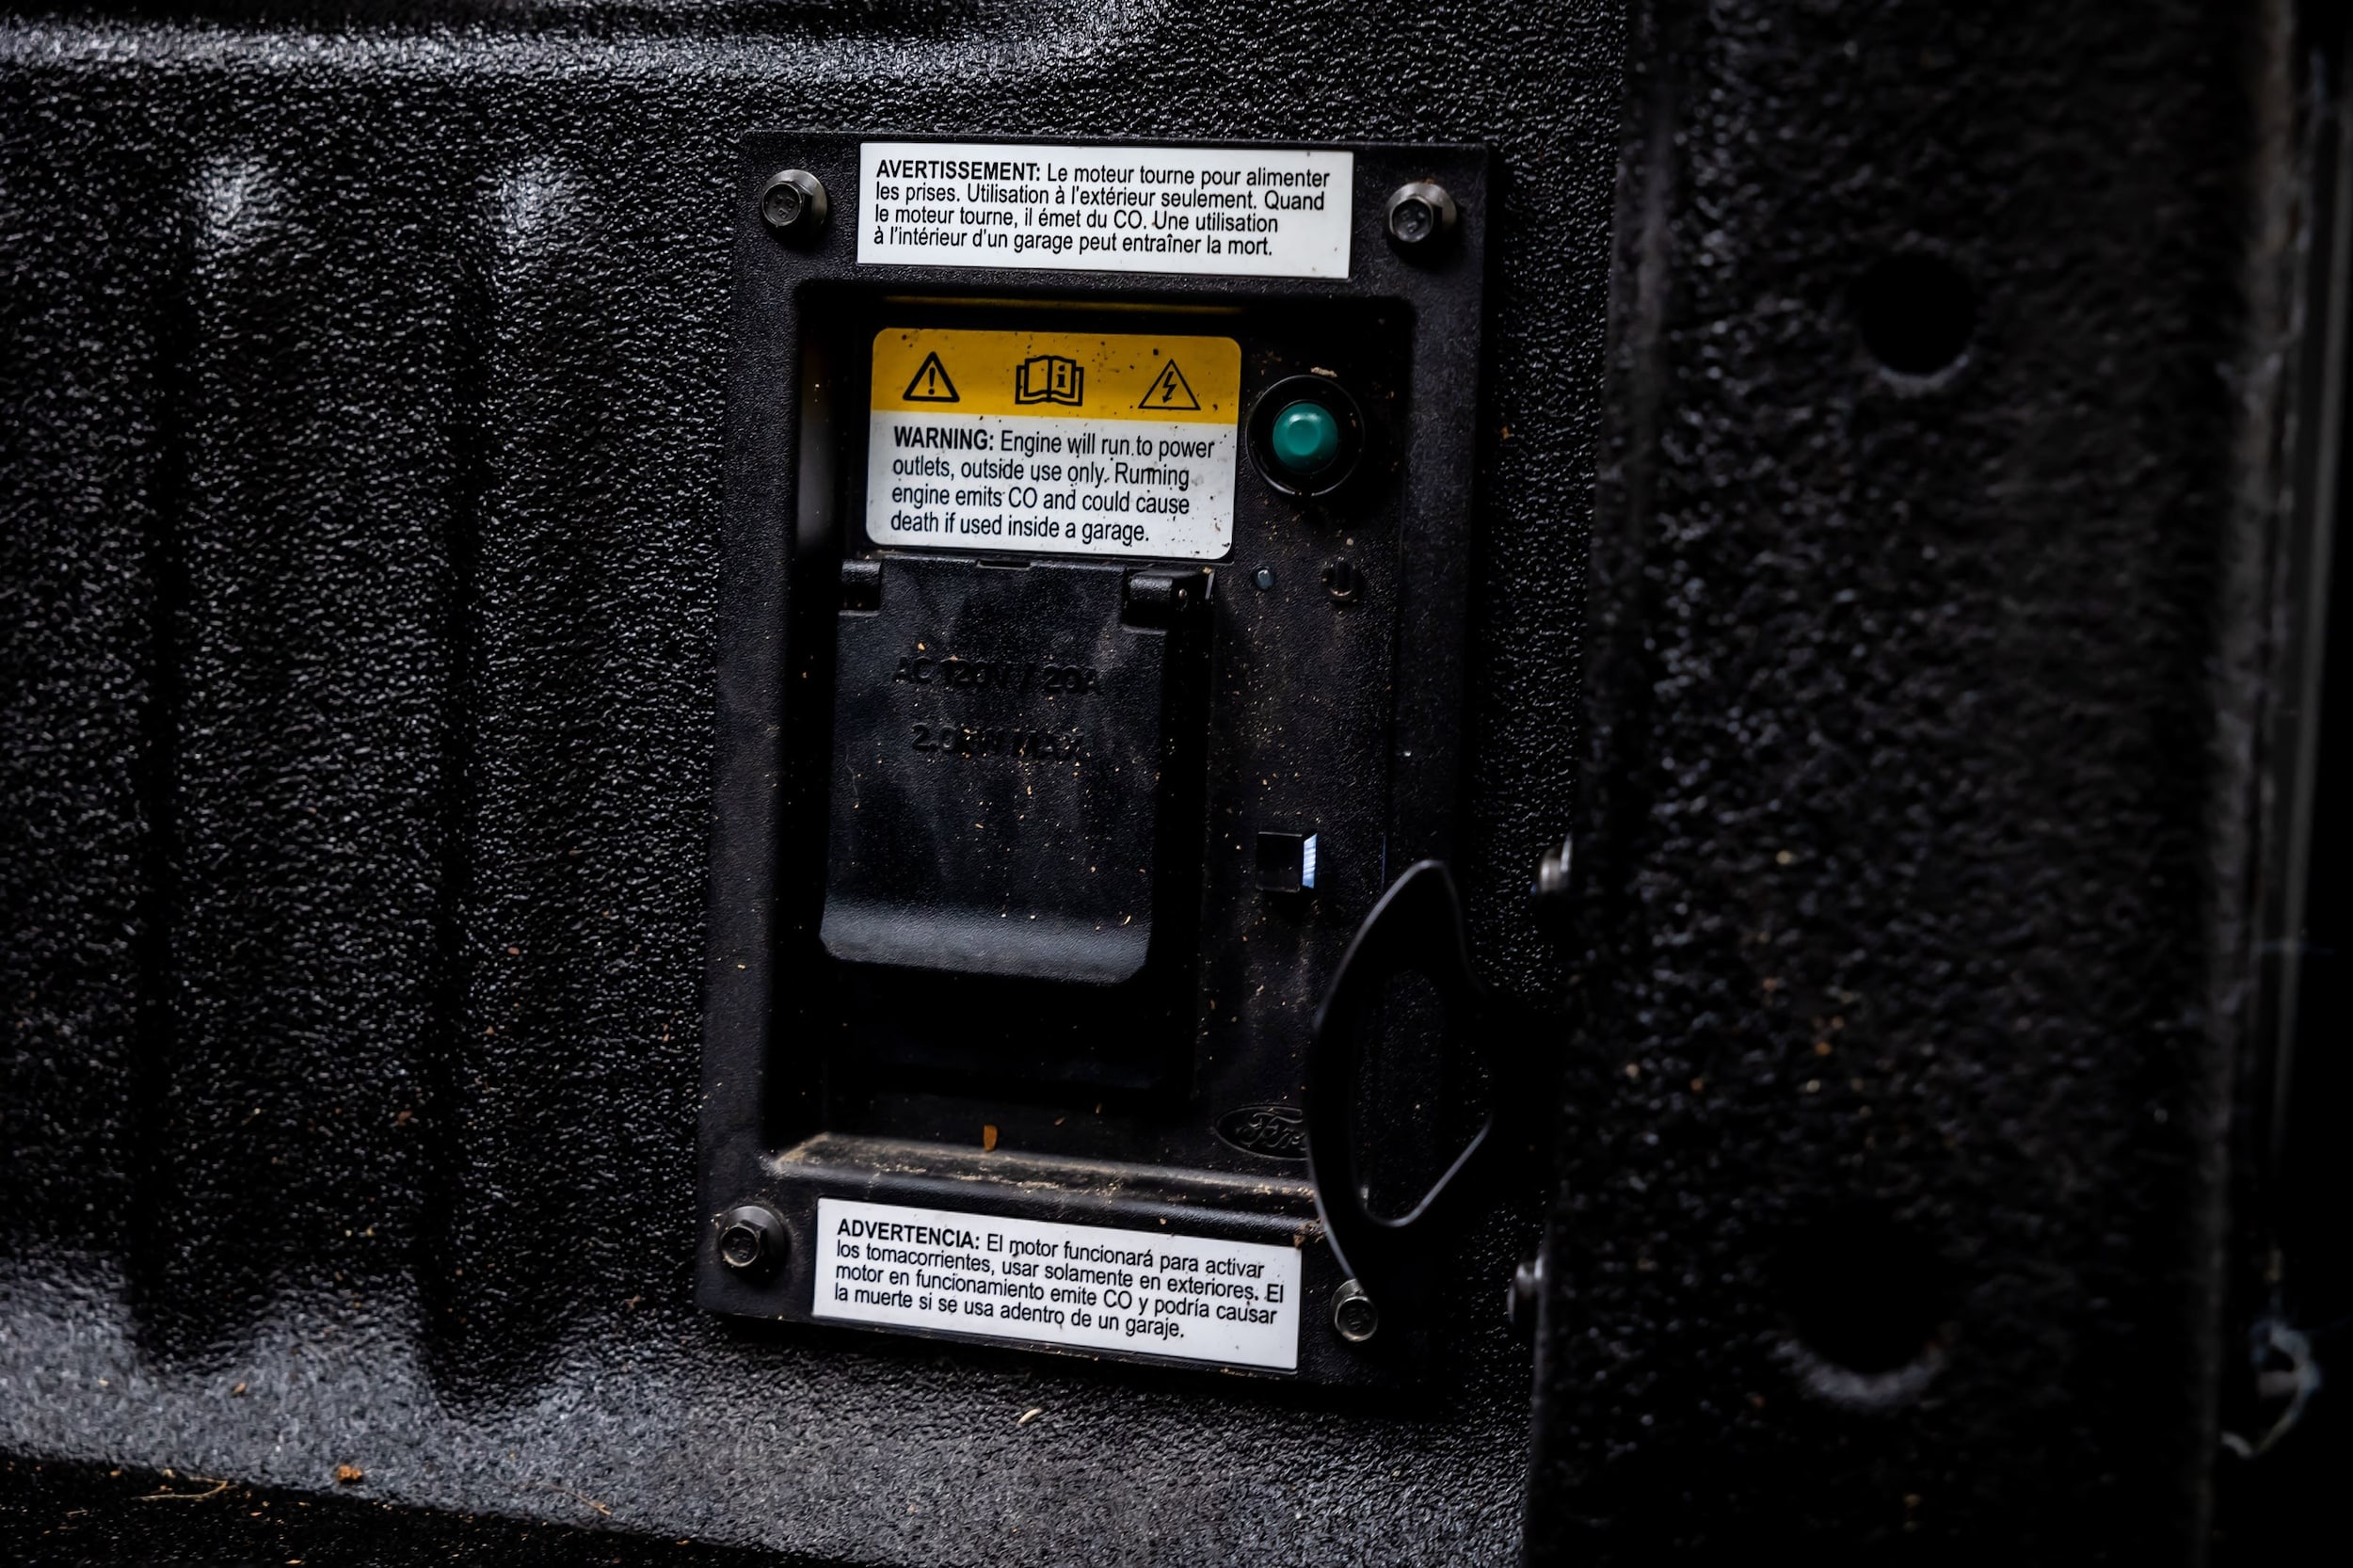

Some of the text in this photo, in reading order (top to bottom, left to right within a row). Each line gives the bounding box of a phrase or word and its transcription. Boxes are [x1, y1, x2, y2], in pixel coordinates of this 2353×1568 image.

[875, 158, 1330, 190] AVERTISSEMENT: Le moteur tourne pour alimenter
[875, 180, 1324, 211] les prises. Utilisation à l'extérieur seulement. Quand
[874, 202, 1278, 232] le moteur tourne, il émet du CO. Une utilisation
[873, 224, 1272, 255] à l'intérieur d'un garage peut entraîner la mort.
[894, 425, 1215, 462] WARNING: Engine will run to power
[892, 453, 1190, 491] outlets, outside use only. Running
[891, 482, 1190, 514] engine emits CO and could cause
[890, 508, 1148, 546] death if used inside a garage.
[893, 657, 934, 683] AC
[837, 1217, 1265, 1279] ADVERTENCIA: El motor funcionará para activar
[837, 1238, 1284, 1304] los tomacorrientes, usar solamente en exteriores. El
[834, 1281, 1184, 1341] la muerte si se usa adentro de un garaje.
[836, 1263, 1277, 1325] motor en funcionamiento emite CO y podría causar
